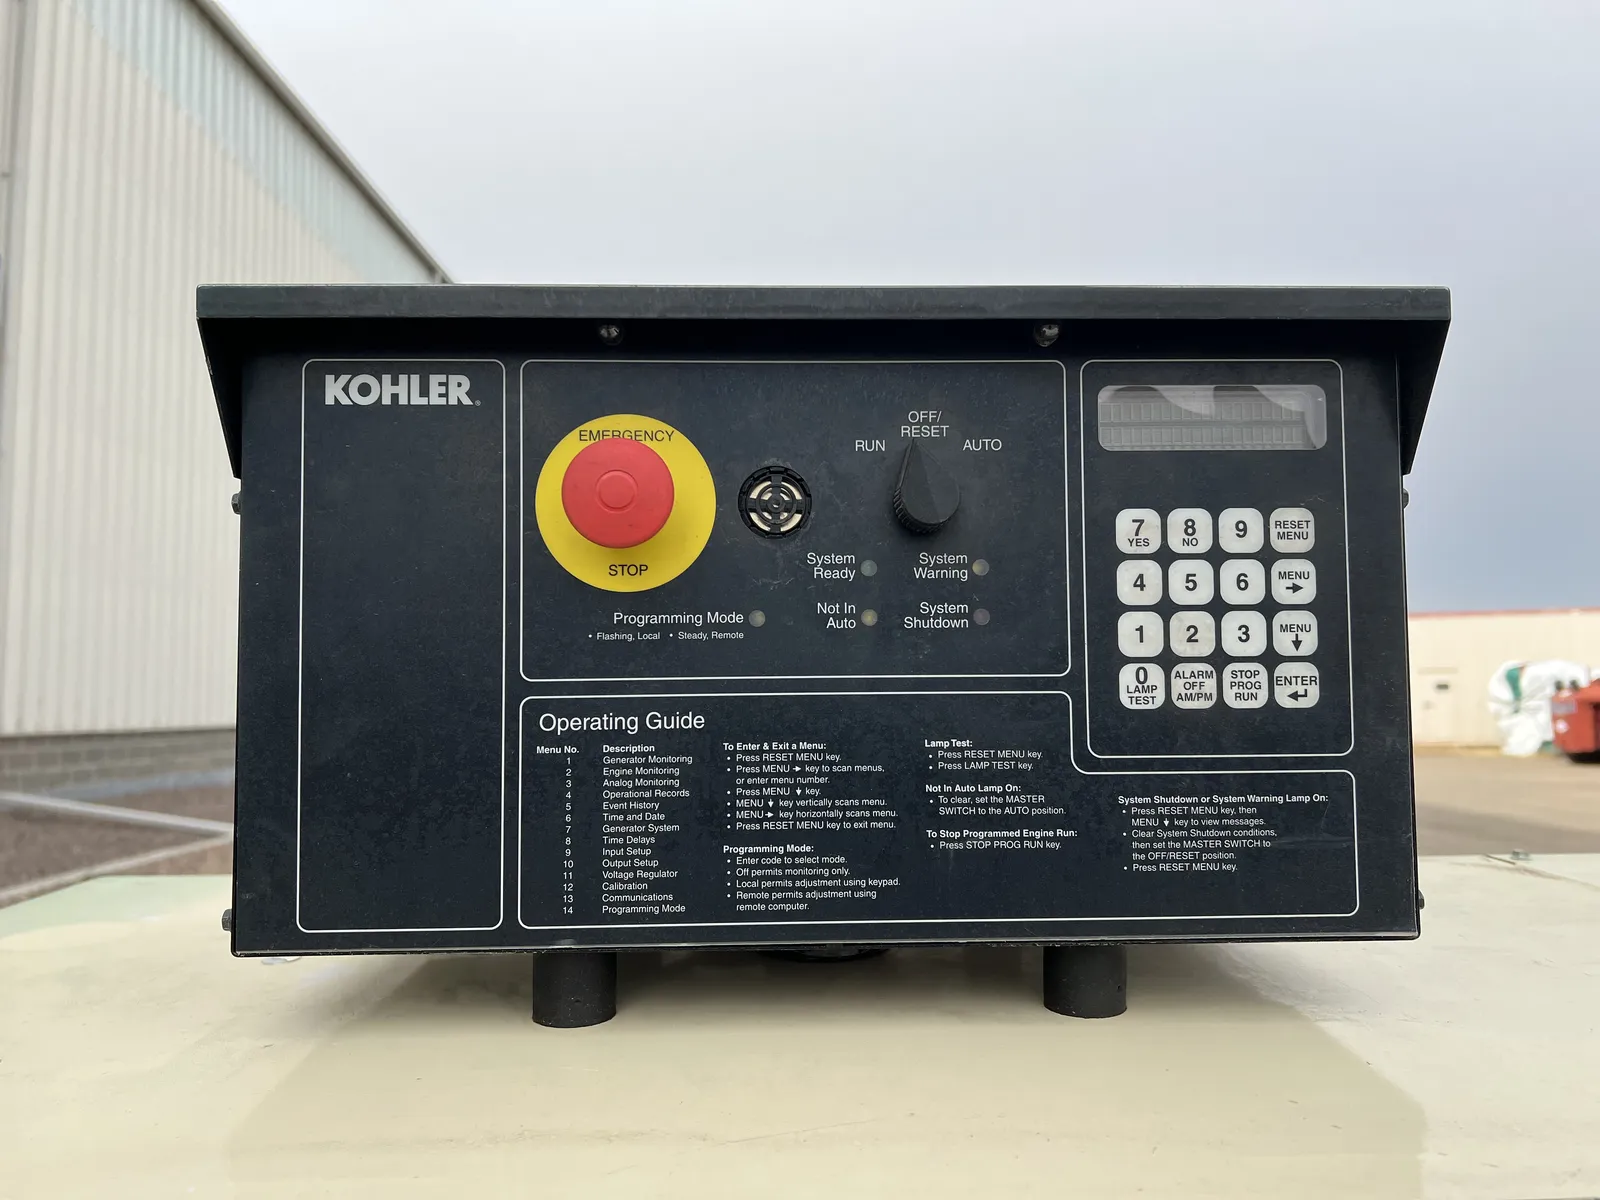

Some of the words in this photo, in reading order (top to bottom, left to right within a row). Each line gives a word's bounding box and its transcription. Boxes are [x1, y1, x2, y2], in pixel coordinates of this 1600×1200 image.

[325, 374, 474, 406] KOHLER
[908, 411, 942, 423] OFF/
[578, 429, 675, 442] EMERGENCY
[901, 425, 950, 438] RESET
[855, 440, 885, 452] RUN
[962, 439, 1002, 451] AUTO
[1131, 519, 1145, 537] 7
[1184, 518, 1197, 537] 8
[1235, 520, 1248, 539] 9
[1274, 520, 1311, 529] RESET
[1277, 531, 1309, 540] MENU
[1128, 538, 1150, 547] YES
[1182, 537, 1199, 547] NO
[807, 552, 856, 568] System
[919, 552, 968, 568] System
[608, 563, 649, 577] STOP
[814, 567, 856, 582] Ready
[913, 567, 968, 582] Warning
[1278, 571, 1310, 580] MENU
[1133, 573, 1147, 592] 4
[1185, 573, 1198, 592] 5
[1236, 572, 1249, 591] 6
[817, 602, 840, 615] Not
[844, 602, 856, 614] In
[920, 601, 969, 617] System
[614, 612, 703, 628] Programming
[707, 611, 744, 624] Mode
[826, 617, 856, 629] Auto
[904, 616, 969, 629] Shutdown
[1186, 624, 1199, 643] 2
[1237, 624, 1250, 643] 3
[1280, 623, 1312, 633] MENU
[597, 632, 635, 642] Flashing,
[638, 632, 661, 640] Local
[678, 631, 709, 641] Steady,
[711, 631, 744, 639] Remote
[1135, 625, 1144, 643] 1
[1135, 666, 1148, 685] 0
[1174, 670, 1214, 679] ALARM
[1231, 669, 1260, 679] STOP
[1183, 681, 1206, 691] OFF
[1230, 680, 1262, 690] PROG
[1275, 675, 1318, 686] ENTER
[1126, 684, 1158, 694] LAMP
[1128, 695, 1157, 705] TEST
[1176, 692, 1213, 702] AM/PM
[1235, 692, 1258, 701] RUN
[539, 712, 638, 736] Operating
[646, 711, 705, 730] Guide
[536, 746, 562, 754] Menu
[564, 745, 579, 754] No.
[603, 744, 655, 754] Description
[722, 743, 734, 751] To
[736, 742, 761, 751] Enter
[762, 742, 770, 751] &
[772, 742, 790, 750] Exit
[799, 742, 827, 750] Menu:
[925, 739, 950, 749] Lamp
[951, 739, 973, 747] Test:
[567, 757, 571, 765] 1
[603, 755, 646, 764] Generator
[648, 755, 693, 765] Monitoring
[736, 754, 760, 762] Press
[762, 753, 794, 762] RESET
[796, 753, 824, 761] MENU
[825, 753, 842, 763] key.
[603, 767, 633, 778] Engine
[635, 766, 680, 777] Monitoring
[938, 762, 963, 770] Press
[964, 761, 990, 770] LAMP
[991, 761, 1016, 770] TEST
[1018, 762, 1034, 772] key.
[565, 768, 572, 777] 2
[565, 780, 572, 788] 3
[602, 778, 633, 789] Analog
[635, 778, 680, 788] Monitoring
[746, 776, 769, 785] enter
[796, 775, 830, 784] number.
[602, 790, 652, 800] Operational
[654, 789, 690, 798] Records
[926, 784, 942, 793] Not
[944, 784, 952, 792] In
[954, 784, 976, 793] Auto
[978, 784, 1003, 794] Lamp
[1005, 784, 1021, 792] On:
[565, 791, 572, 799] 4
[1118, 796, 1152, 806] System
[1154, 795, 1199, 804] Shutdown
[1212, 795, 1246, 805] System
[1247, 794, 1284, 805] Warning
[1286, 794, 1311, 804] Lamp
[1312, 794, 1329, 802] On:
[565, 802, 572, 811] 5
[603, 801, 627, 810] Event
[629, 801, 660, 811] History
[736, 799, 764, 808] MENU
[779, 799, 794, 809] key
[795, 798, 833, 808] vertically
[602, 813, 624, 821] Time
[626, 812, 643, 821] and
[645, 812, 665, 821] Date
[939, 806, 976, 816] SWITCH
[978, 807, 987, 815] to
[988, 806, 1002, 815] the
[1003, 806, 1030, 815] AUTO
[1031, 807, 1067, 816] position.
[565, 814, 572, 822] 6
[565, 825, 571, 834] 7
[602, 824, 646, 833] Generator
[647, 823, 680, 834] System
[565, 836, 571, 846] 8
[602, 836, 624, 845] Time
[626, 836, 656, 846] Delays
[939, 841, 964, 850] Press
[965, 840, 992, 850] STOP
[993, 840, 1021, 849] PROG
[1023, 840, 1044, 849] RUN
[1045, 840, 1062, 851] key.
[565, 848, 571, 857] 9
[602, 848, 624, 858] Input
[626, 847, 652, 857] Setup
[723, 844, 784, 855] Programming
[786, 844, 814, 853] Mode:
[1132, 852, 1146, 861] the
[1148, 851, 1200, 861] OFF/RESET
[1202, 852, 1237, 862] position.
[563, 859, 574, 869] 10
[602, 858, 631, 869] Output
[633, 858, 659, 868] Setup
[563, 872, 572, 880] 11
[602, 870, 634, 881] Voltage
[636, 869, 678, 881] Regulator
[563, 883, 574, 892] 12
[602, 882, 648, 891] Calibration
[736, 879, 759, 888] Local
[761, 879, 793, 889] permits
[794, 879, 841, 889] adjustment
[843, 879, 866, 888] using
[868, 878, 901, 888] keypad.
[563, 894, 574, 903] 13
[602, 893, 674, 902] Communications
[563, 906, 573, 914] 14
[602, 904, 660, 916] Programming
[661, 904, 686, 913] Mode
[736, 903, 766, 911] remote
[768, 902, 810, 912] computer.
